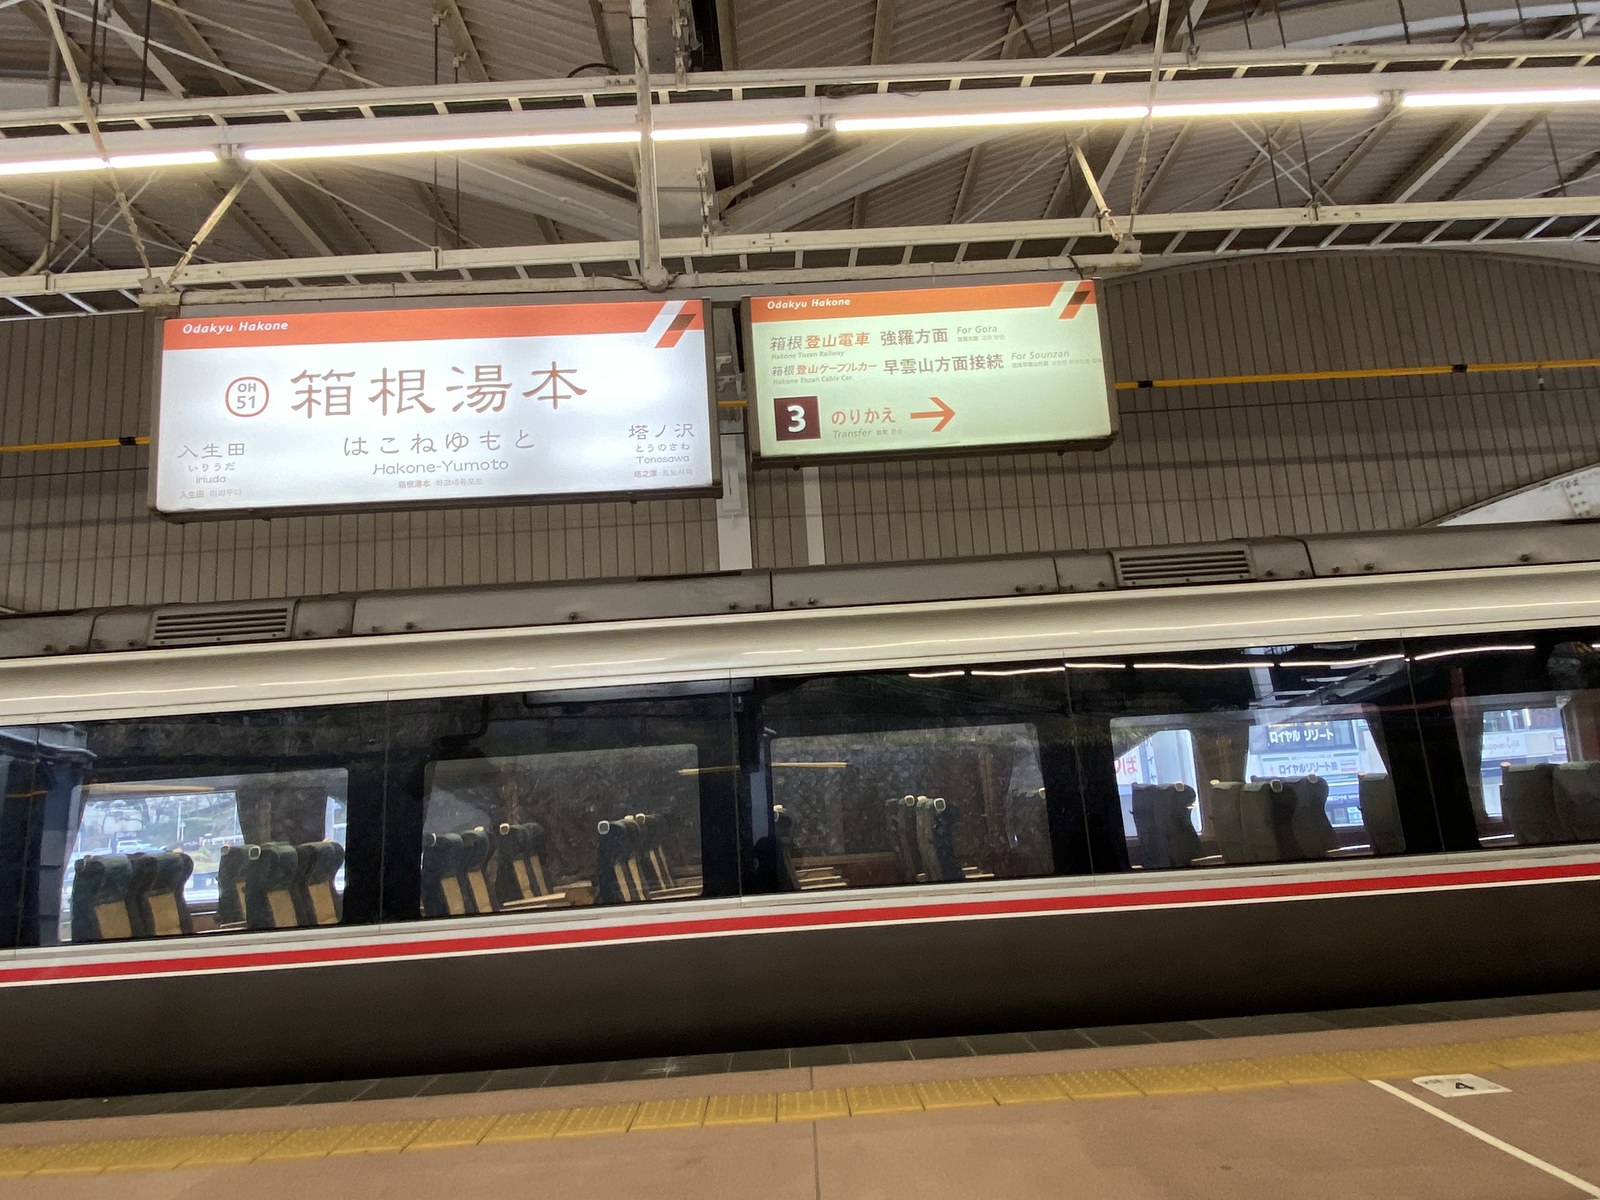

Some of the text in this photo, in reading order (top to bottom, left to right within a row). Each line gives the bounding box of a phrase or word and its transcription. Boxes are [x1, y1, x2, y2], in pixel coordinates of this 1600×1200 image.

[767, 298, 851, 311] Odakyu Hakone
[183, 320, 289, 336] Odakyu Hakone
[957, 325, 998, 335] For Gora
[770, 332, 870, 351] 箱根登山電車
[880, 328, 949, 347] 強羅方面
[771, 353, 797, 361] Hakone
[1011, 350, 1070, 361] For Sounzan
[772, 361, 878, 377] 箱根登山ケーブルカー
[883, 353, 1005, 376] 早雲山方面接続
[237, 382, 257, 392] OH
[773, 377, 799, 385] Hakone
[290, 360, 587, 420] 箱根湯本
[236, 395, 256, 410] 51
[787, 405, 807, 433] 3
[831, 407, 896, 426] のりかえ
[628, 423, 696, 442] 塔ノ沢
[833, 429, 872, 440] Transfer
[343, 429, 535, 457] はこねゆもと
[635, 442, 691, 453] とうのさわ
[177, 443, 246, 460] 入生田
[636, 454, 690, 465] Tonosawa
[188, 461, 236, 473] いりうだ
[372, 458, 509, 476] Hakone-Yumoto
[195, 474, 227, 485] Iriuda
